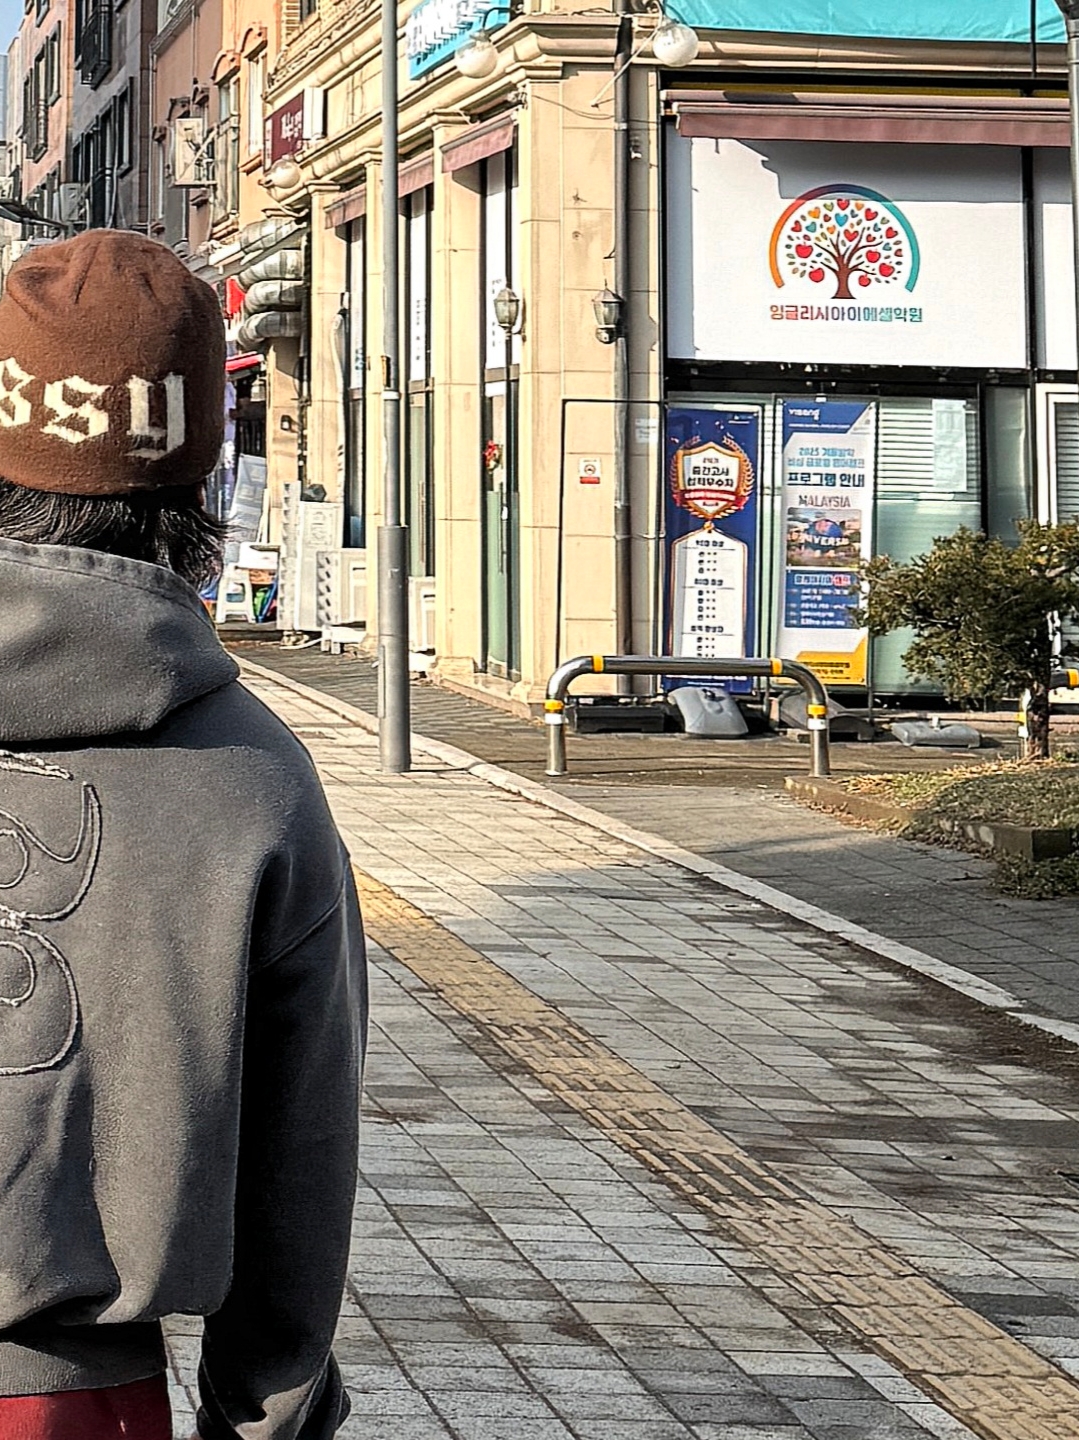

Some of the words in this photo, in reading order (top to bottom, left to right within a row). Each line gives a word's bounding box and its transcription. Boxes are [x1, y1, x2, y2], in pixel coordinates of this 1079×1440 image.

[787, 472, 837, 487] 프로그램
[839, 473, 865, 488] 안내
[798, 494, 851, 508] MALAYSIA
